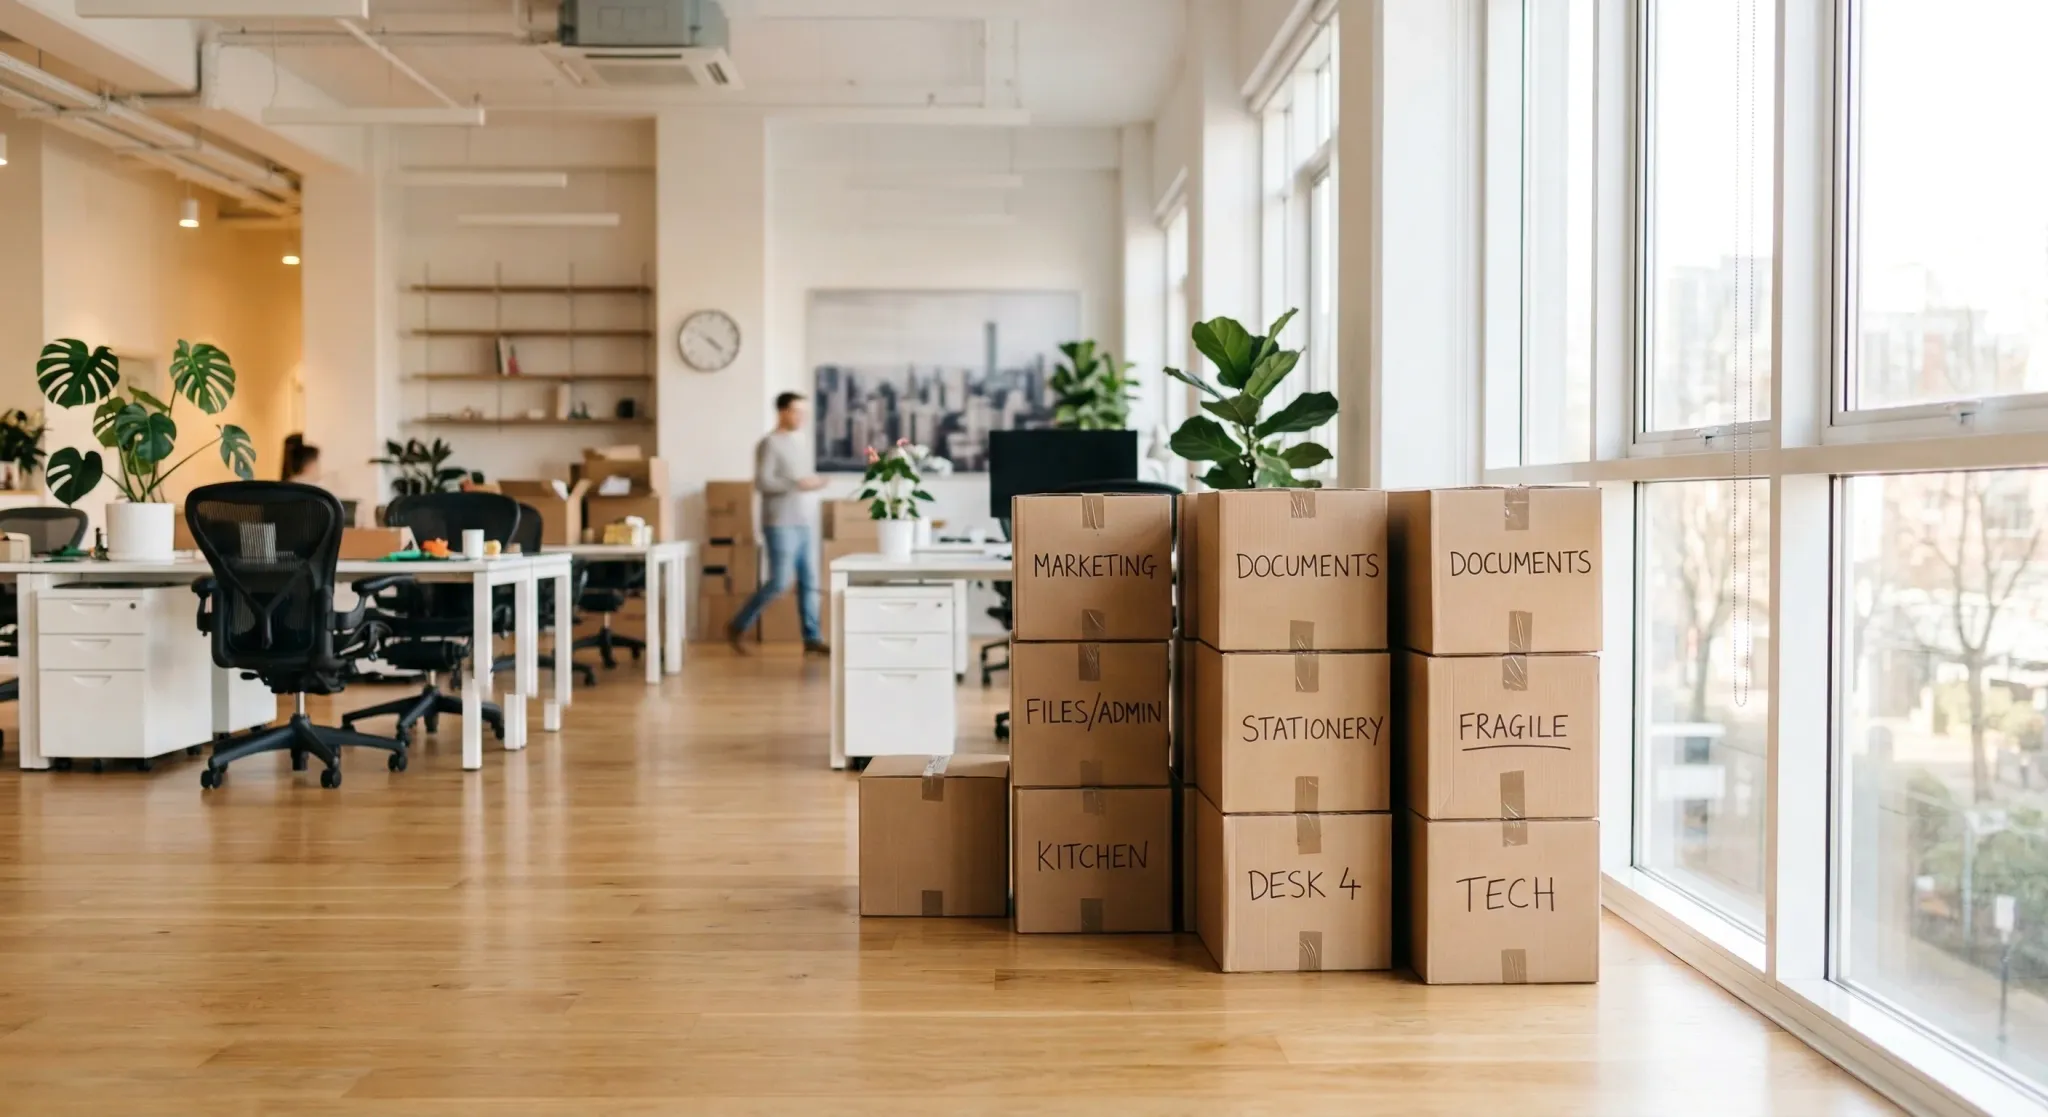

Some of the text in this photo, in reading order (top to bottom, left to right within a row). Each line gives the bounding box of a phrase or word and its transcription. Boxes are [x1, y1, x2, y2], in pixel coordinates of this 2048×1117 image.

[1035, 553, 1157, 579] MARKETING
[1237, 553, 1380, 579] DOCUMENTS
[1450, 550, 1592, 577] DOCUMENTS
[1028, 693, 1162, 731] FILES/ADMIN
[1459, 712, 1569, 741] FRAGILE
[1242, 715, 1384, 746] STATIONERY
[1038, 840, 1149, 871] KITCHEN
[1248, 866, 1362, 902] DESK 4
[1456, 875, 1555, 913] TECH
